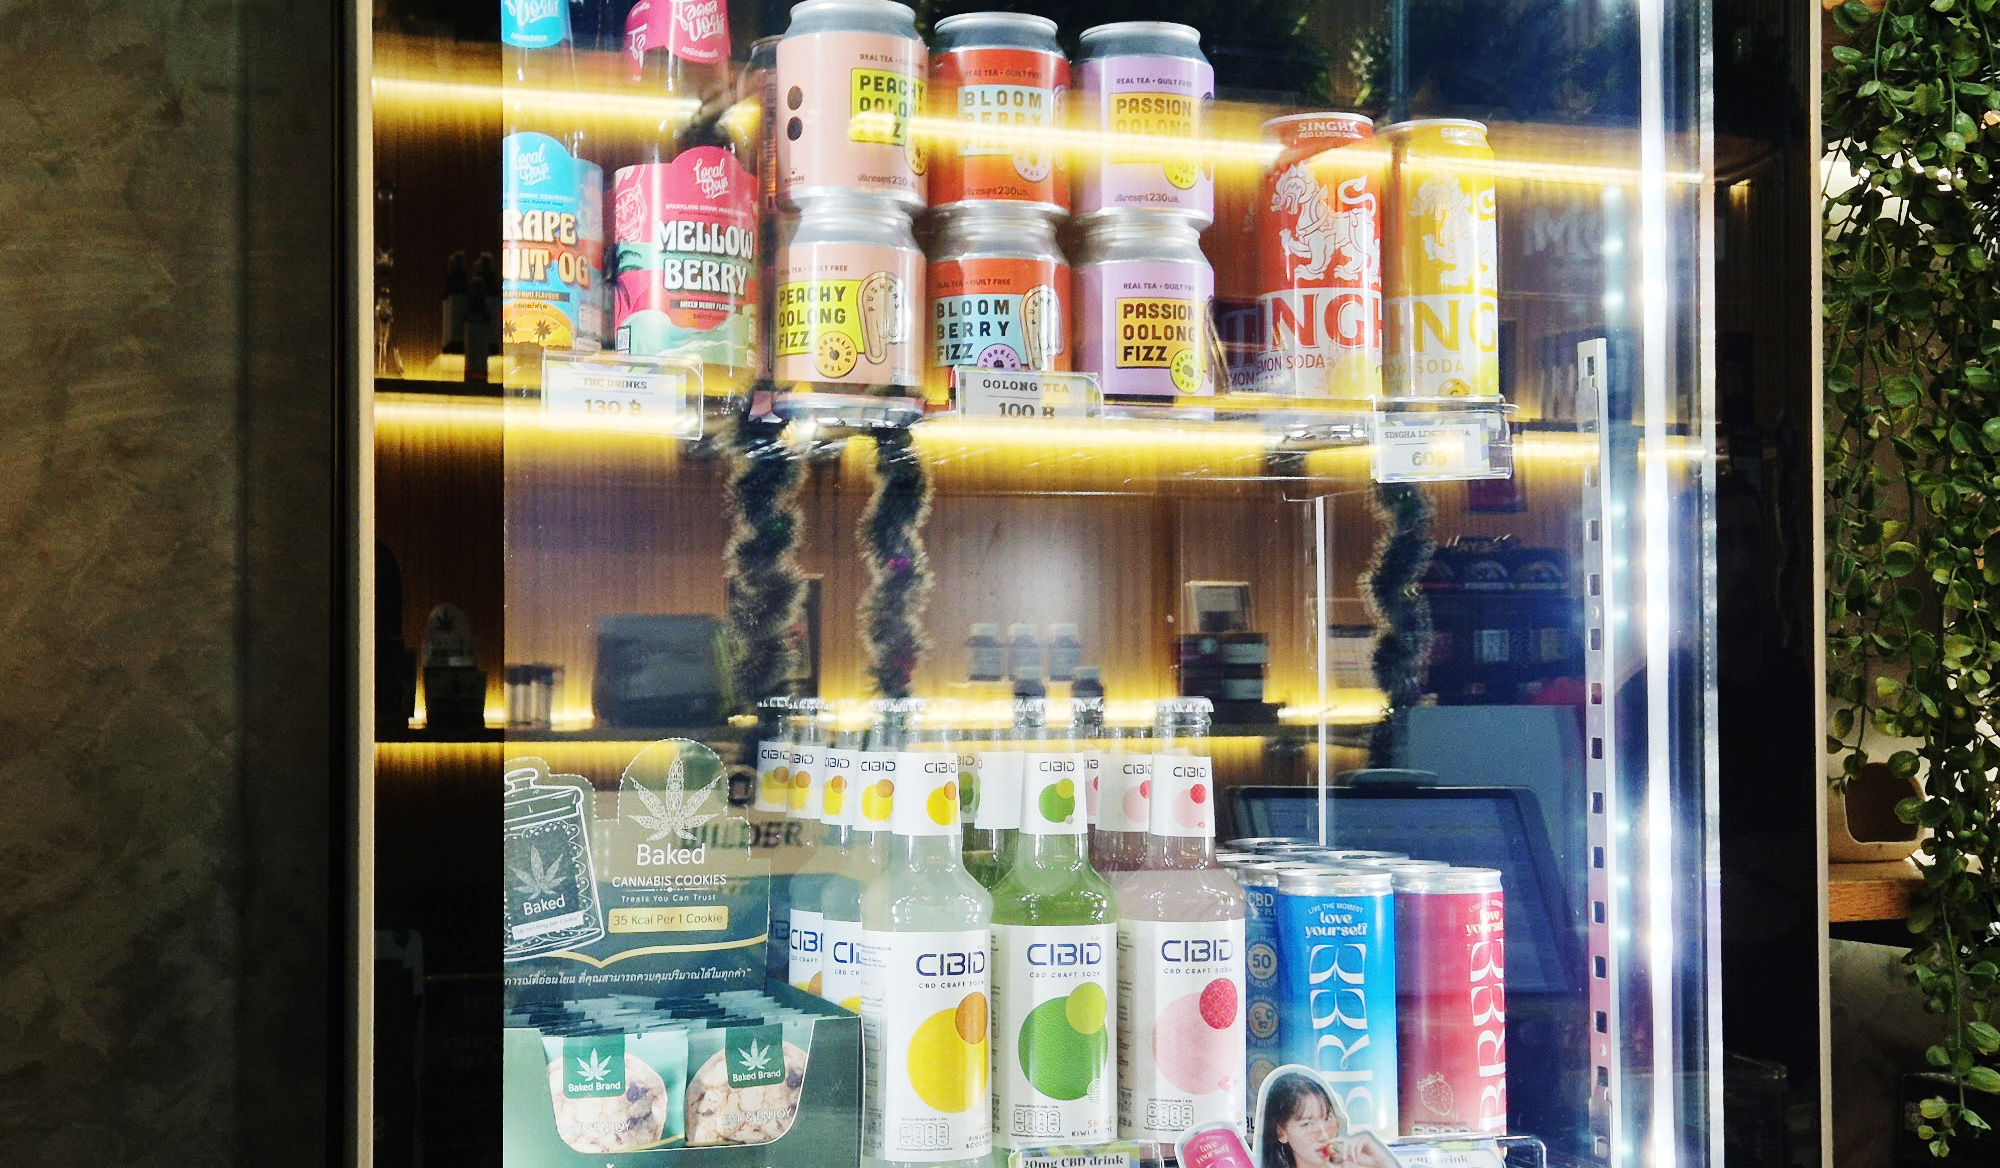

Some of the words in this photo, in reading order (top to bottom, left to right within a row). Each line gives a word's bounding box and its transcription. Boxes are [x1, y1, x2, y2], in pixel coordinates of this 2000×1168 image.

[880, 55, 893, 63] TEA
[964, 90, 1042, 109] BLOOM
[1116, 97, 1192, 116] PASSION
[1298, 121, 1360, 132] SINGHA
[693, 157, 731, 185] Local
[654, 220, 753, 260] MELLOW
[558, 252, 588, 289] OG
[808, 265, 828, 273] GILT
[664, 258, 746, 296] BERRY
[993, 278, 1011, 286] FREE
[1164, 283, 1183, 291] GUILT
[778, 286, 846, 307] PEACHY
[936, 299, 1010, 319] BLOOM
[1123, 303, 1195, 320] PASSION
[778, 307, 846, 328] OOLONG
[936, 321, 1010, 340] BERRY
[778, 331, 809, 350] FIZZ
[936, 343, 973, 361] FIZZ
[1123, 346, 1168, 361] FIZZ
[1286, 354, 1325, 369] SODA
[1416, 359, 1465, 374] SODA
[583, 378, 604, 388] THC
[607, 379, 647, 390] DRINKS
[982, 379, 1038, 392] OOLONG
[1043, 383, 1070, 394] TEA
[584, 399, 622, 415] 130
[998, 402, 1035, 419] 100
[1384, 430, 1416, 439] SINGHA
[861, 761, 896, 772] CIBID
[1039, 761, 1075, 772] CIBID
[1173, 766, 1207, 778] CIBID
[637, 842, 706, 866] Baked
[612, 875, 671, 888] CANNABIS
[675, 874, 727, 886] COOKIES
[523, 894, 566, 916] Baked
[621, 895, 649, 903] Treats
[672, 894, 689, 902] Can
[693, 893, 716, 901] Trust
[1248, 893, 1274, 908] CBD
[1308, 904, 1322, 915] LIVE
[1322, 902, 1335, 910] THE
[1336, 902, 1364, 913] MOMENT
[613, 915, 628, 926] 35
[631, 914, 653, 925] Kcal
[657, 914, 675, 924] Per
[677, 913, 683, 922] 1
[686, 912, 723, 924] Cookie
[1320, 911, 1353, 924] love
[1305, 922, 1368, 939] yourself
[790, 928, 823, 953] CIBI
[1026, 942, 1102, 966] CIBID
[1161, 939, 1233, 962] CIBID
[915, 950, 985, 977] CIBID
[1252, 954, 1272, 969] 50
[940, 981, 966, 989] CRAFT
[732, 1071, 757, 1082] Baked
[758, 1068, 781, 1079] Brand
[568, 1081, 593, 1092] Baked
[595, 1080, 621, 1091] Brand
[745, 1112, 754, 1122] &
[756, 1107, 793, 1121] ENJOY
[594, 1120, 631, 1134] ENJOY
[1061, 1157, 1086, 1167] CBD
[1090, 1155, 1123, 1165] drink
